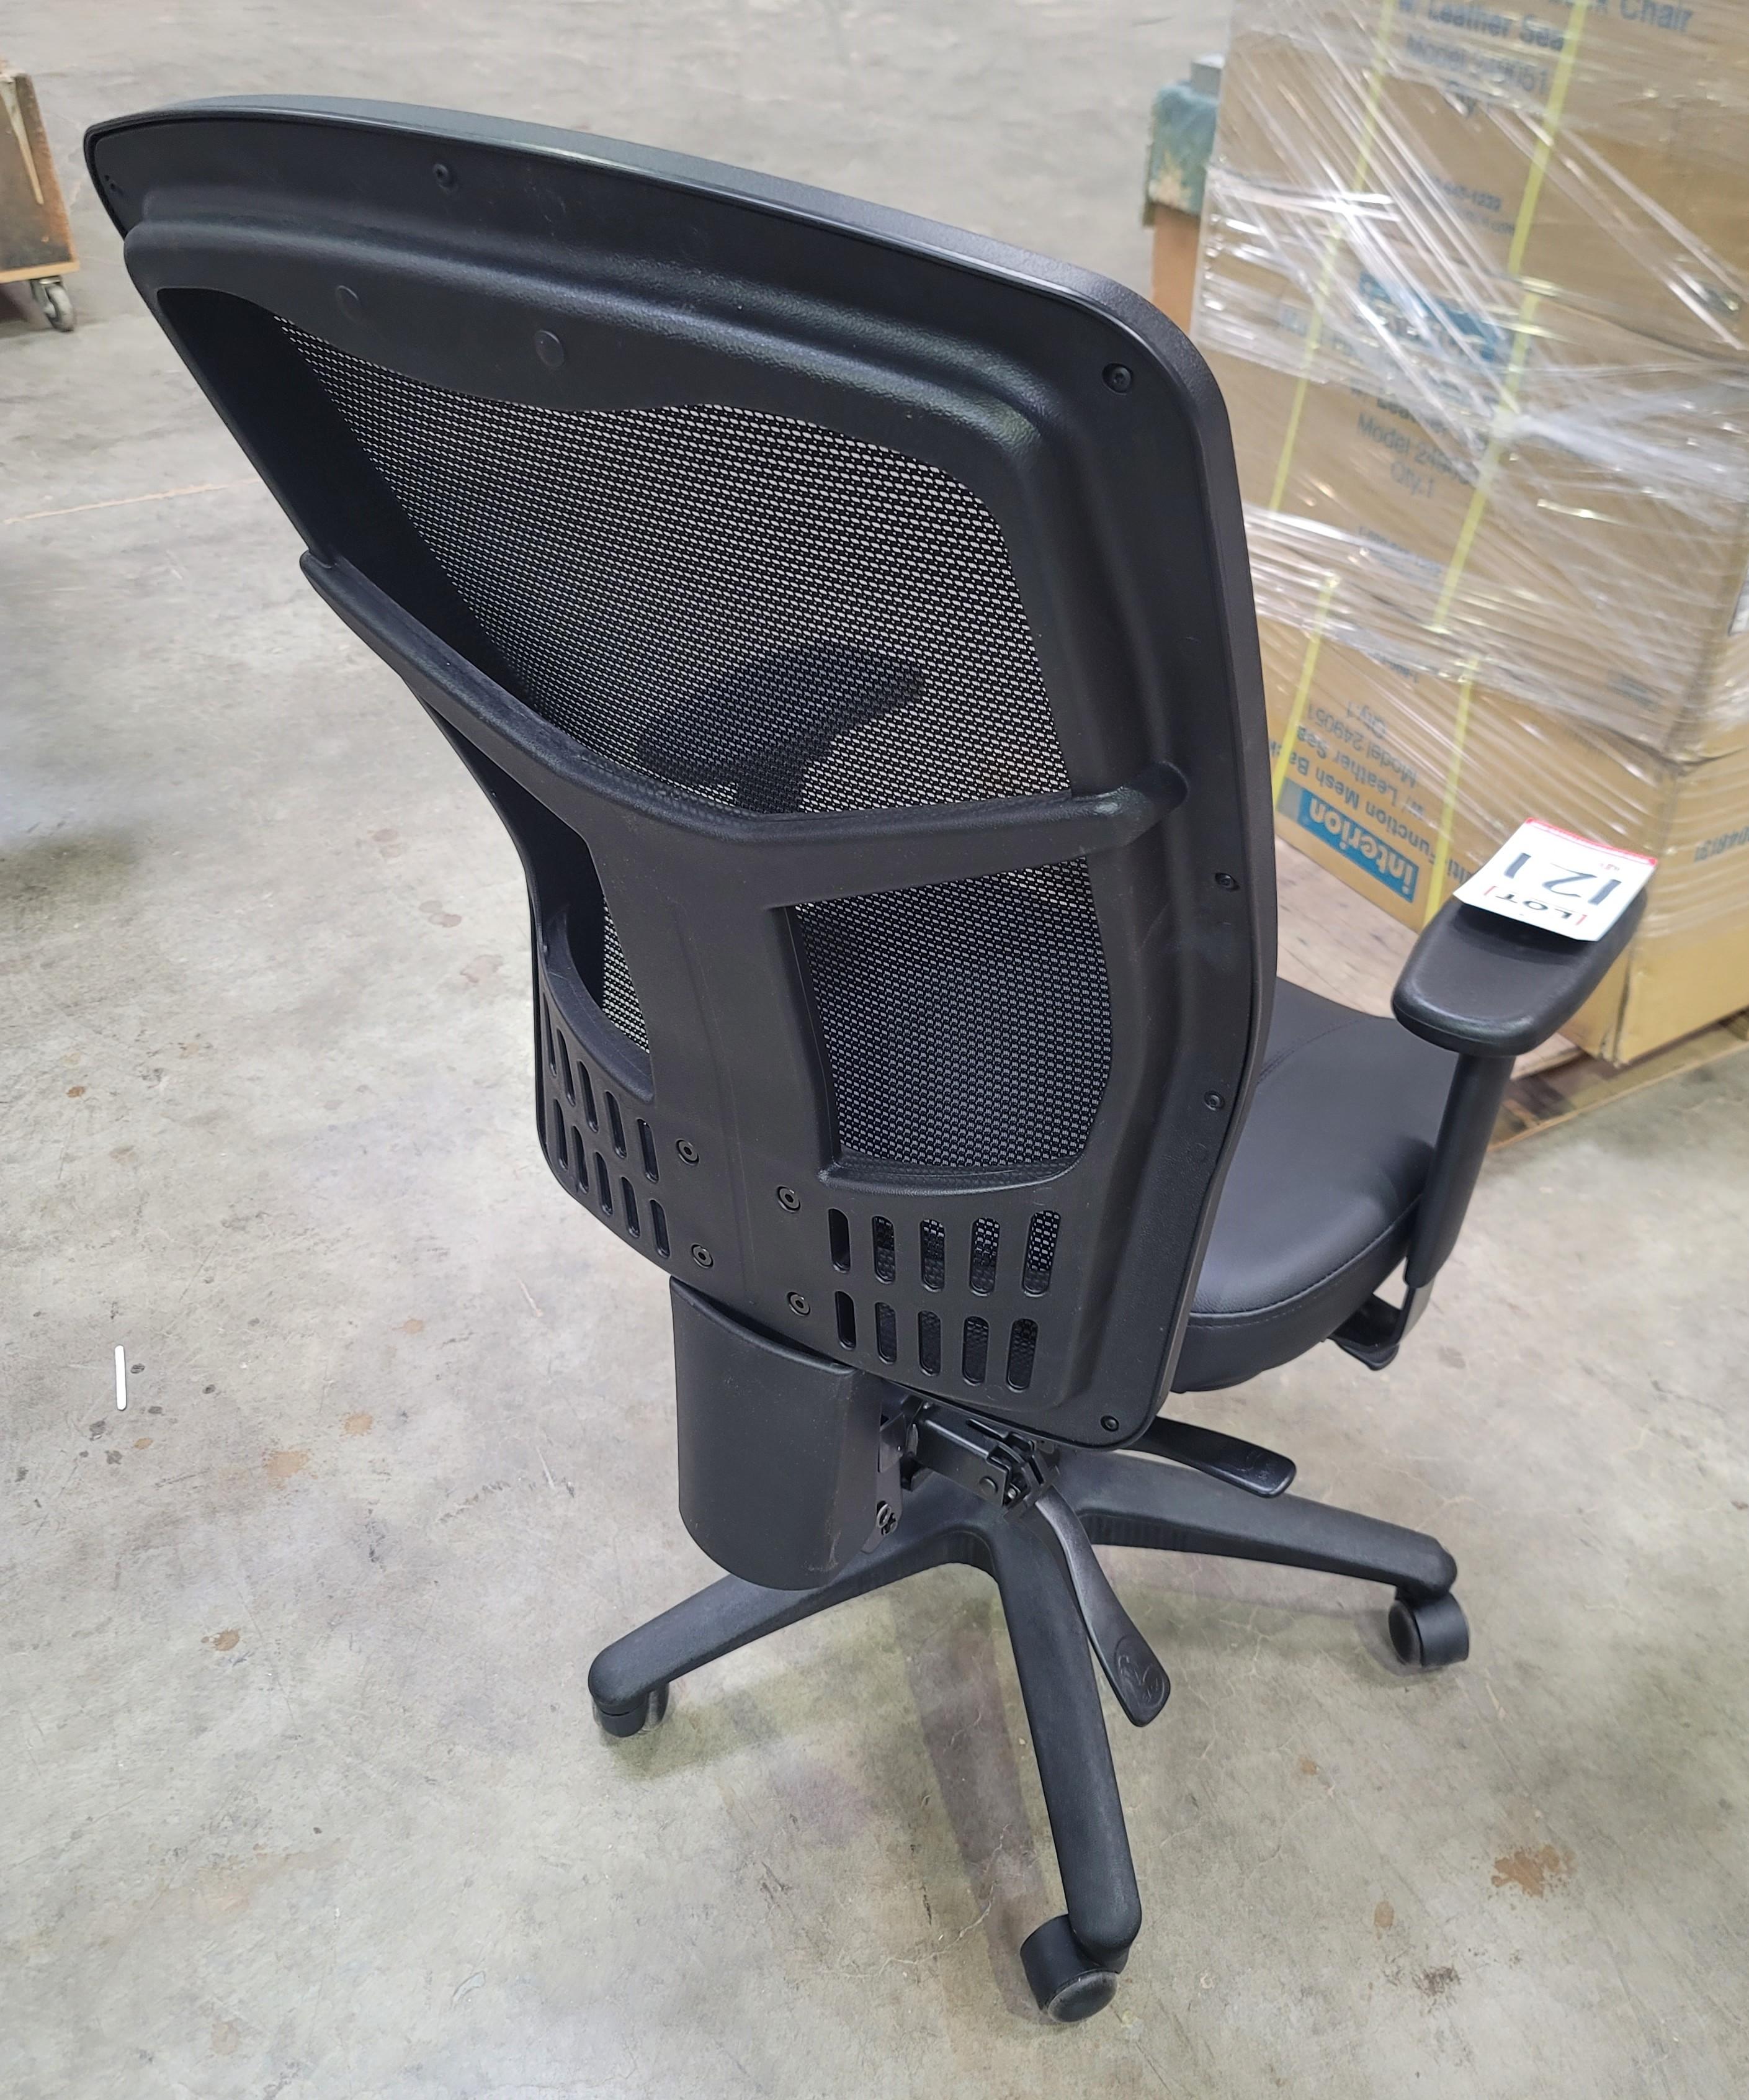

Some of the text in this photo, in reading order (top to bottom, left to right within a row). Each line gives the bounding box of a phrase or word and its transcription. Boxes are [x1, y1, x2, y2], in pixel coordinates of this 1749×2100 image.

[1519, 14, 1564, 52] Sea
[1620, 0, 1694, 31] Chair
[1357, 412, 1411, 456] Model
[1307, 705, 1419, 789] Model 249051
[1315, 766, 1361, 810] Mesh
[1334, 748, 1399, 805] Leather
[1308, 796, 1415, 895] interion
[1503, 852, 1622, 907] 121
[1495, 894, 1573, 920] LOT
